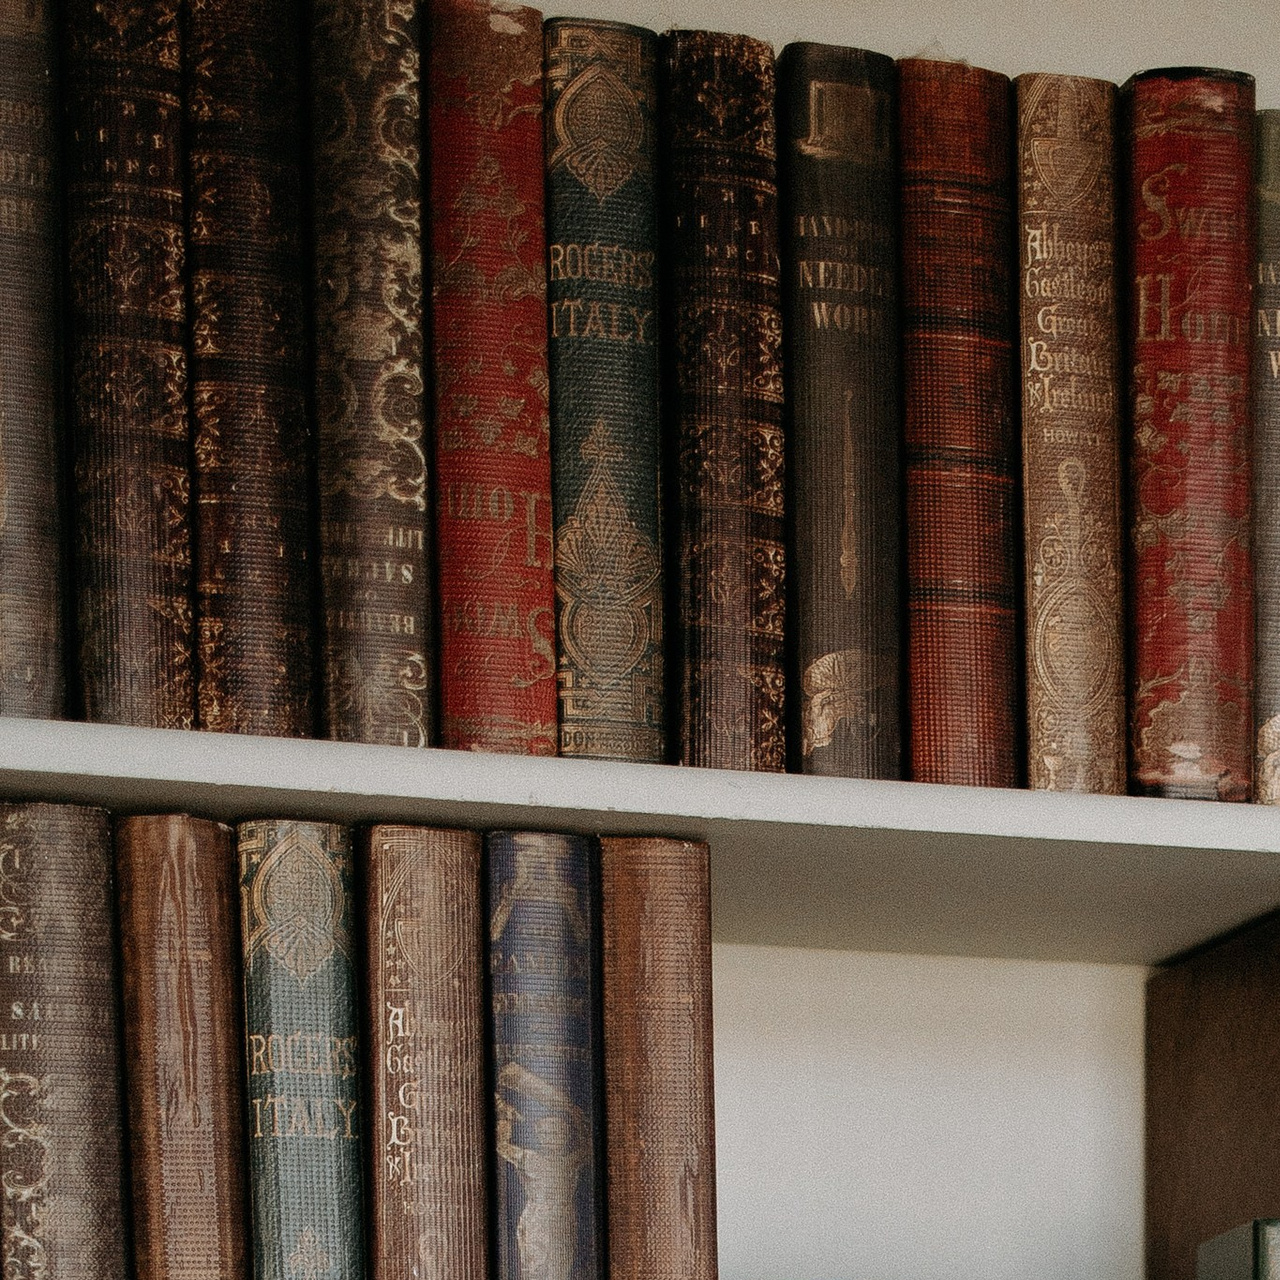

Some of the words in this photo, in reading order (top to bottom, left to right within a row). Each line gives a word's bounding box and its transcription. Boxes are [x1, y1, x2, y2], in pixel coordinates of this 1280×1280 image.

[550, 243, 655, 290] ROGERS
[551, 298, 653, 343] ITALY
[249, 1030, 357, 1080] ROGERS
[252, 1094, 359, 1140] ITALY
